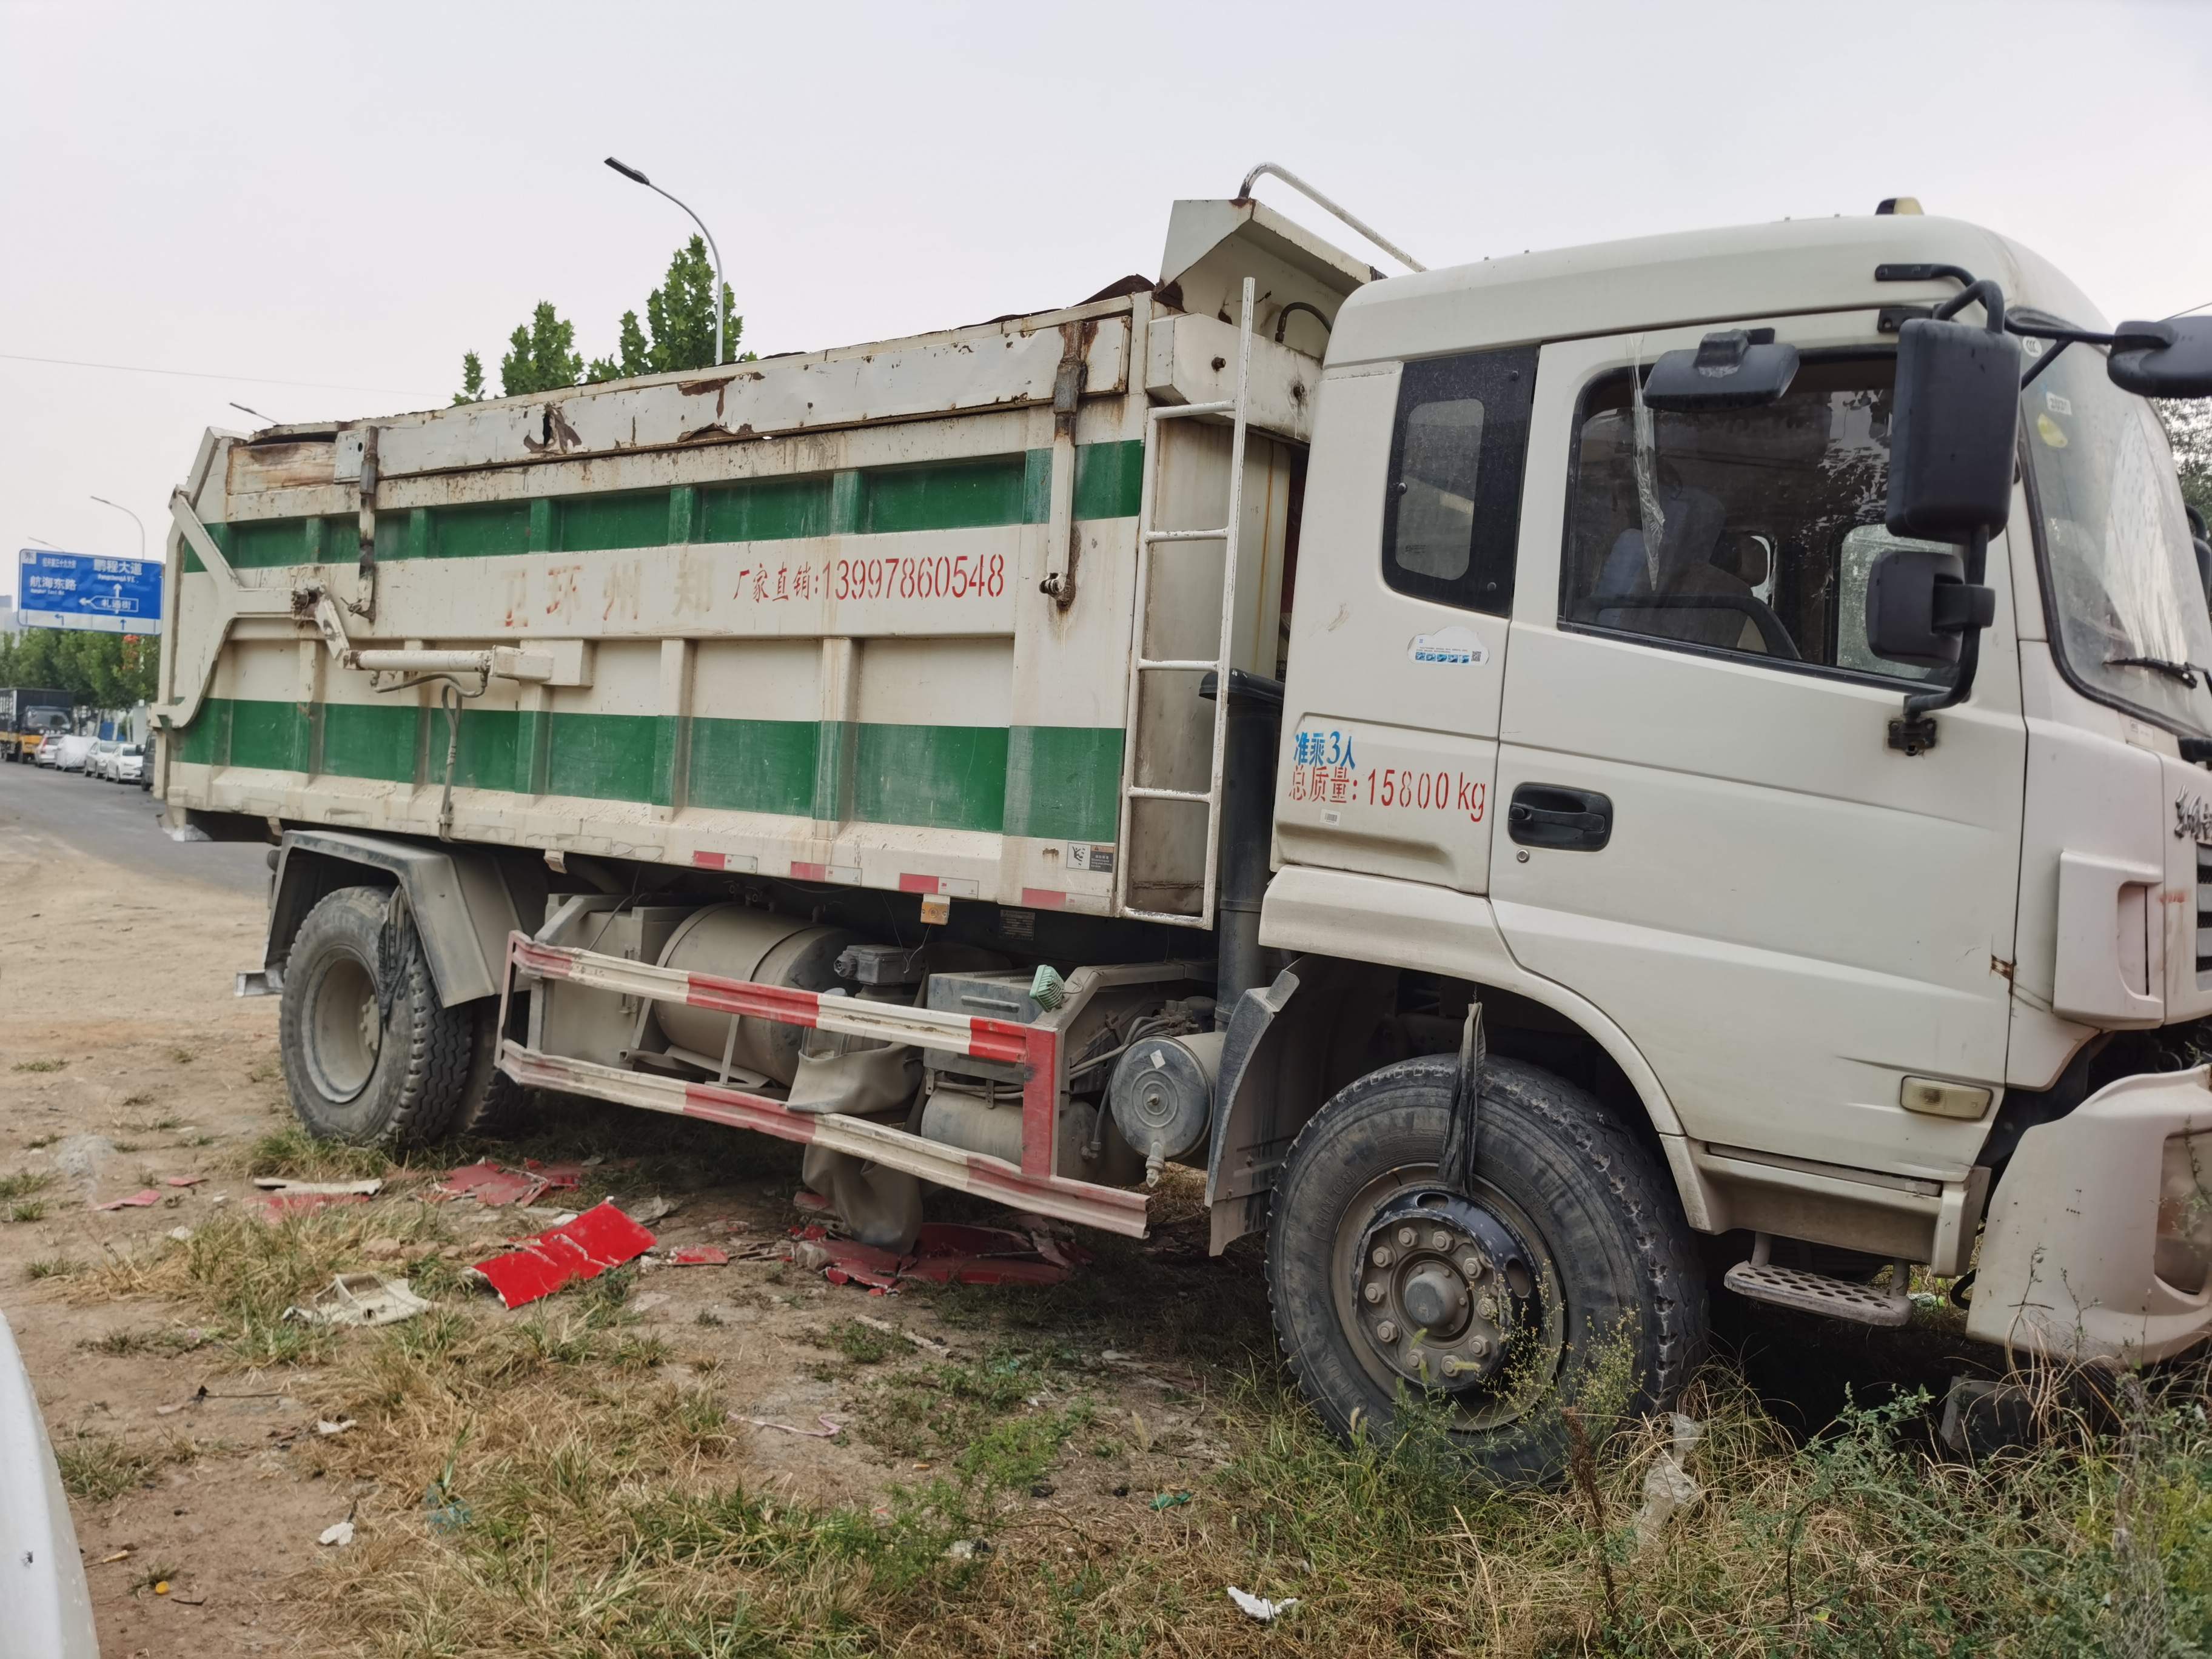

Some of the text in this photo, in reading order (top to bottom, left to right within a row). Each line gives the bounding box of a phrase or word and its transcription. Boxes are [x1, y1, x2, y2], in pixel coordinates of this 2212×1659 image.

[93, 559, 142, 575] 鹏程大道
[30, 576, 76, 591] 航海东路
[1292, 731, 1356, 770] 准乘3人
